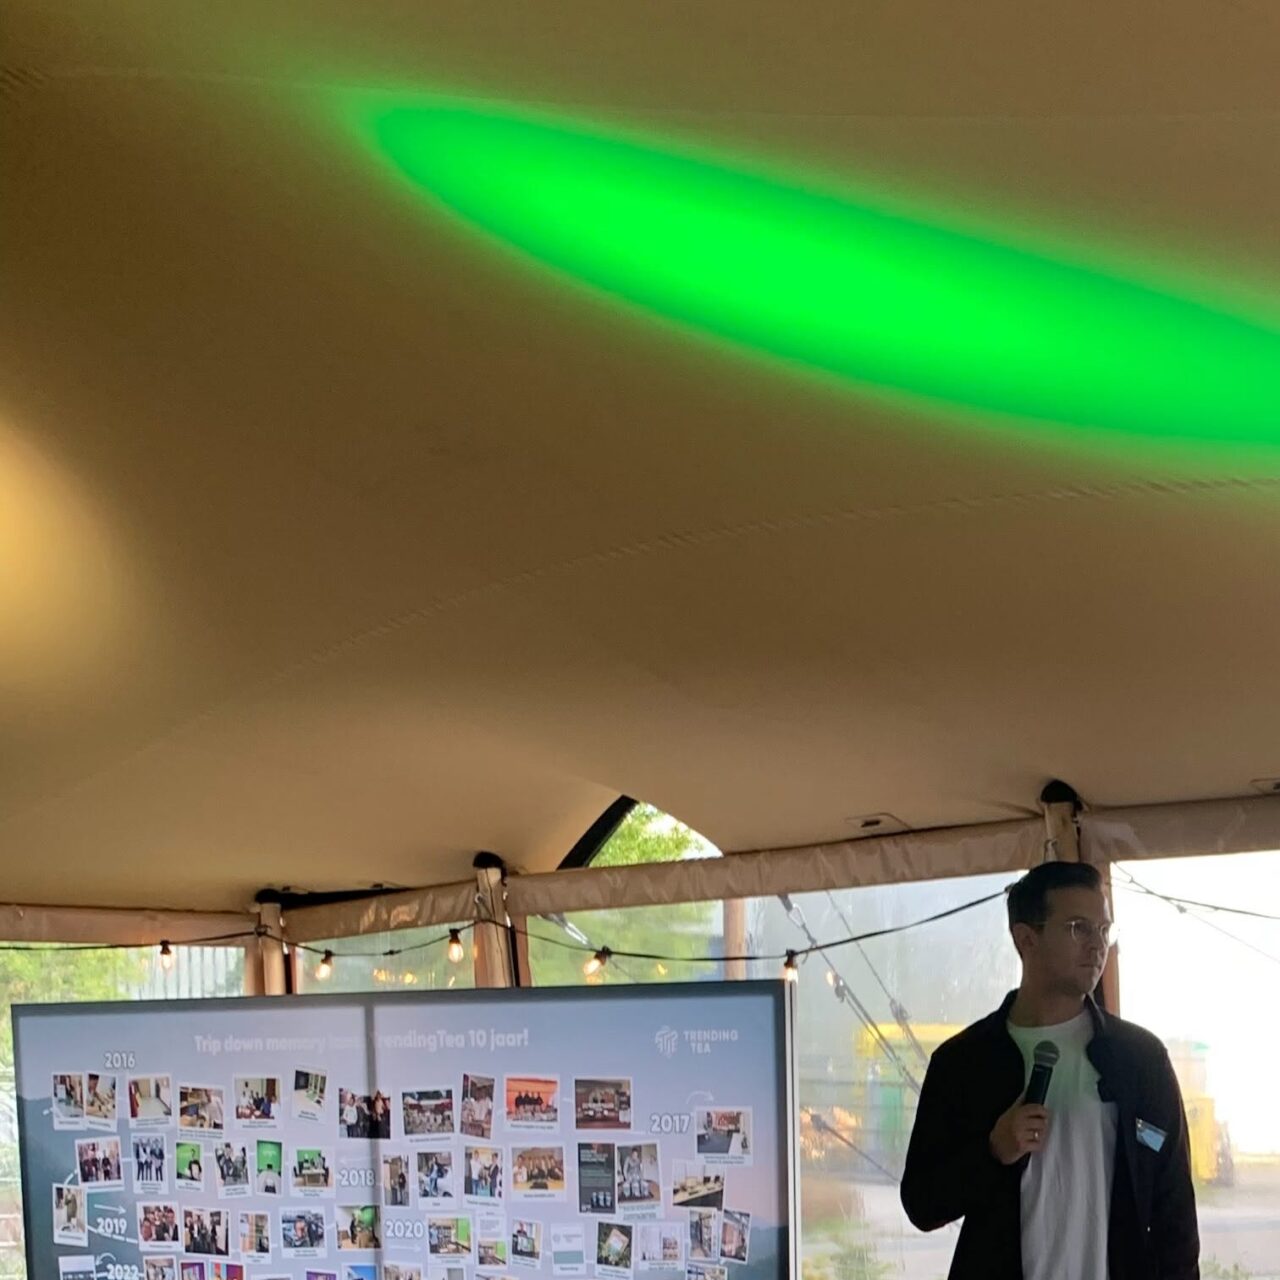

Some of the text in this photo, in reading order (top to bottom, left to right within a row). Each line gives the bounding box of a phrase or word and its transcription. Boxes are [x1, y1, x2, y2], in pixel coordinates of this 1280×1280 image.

[193, 1034, 219, 1056] Trip
[222, 1034, 261, 1051] down
[467, 1029, 486, 1048] 10
[488, 1028, 528, 1051] jaar!
[104, 1052, 136, 1069] 2016
[650, 1114, 690, 1135] 2017
[339, 1168, 375, 1187] 2018
[97, 1217, 128, 1235] 2019
[385, 1221, 424, 1240] 2020
